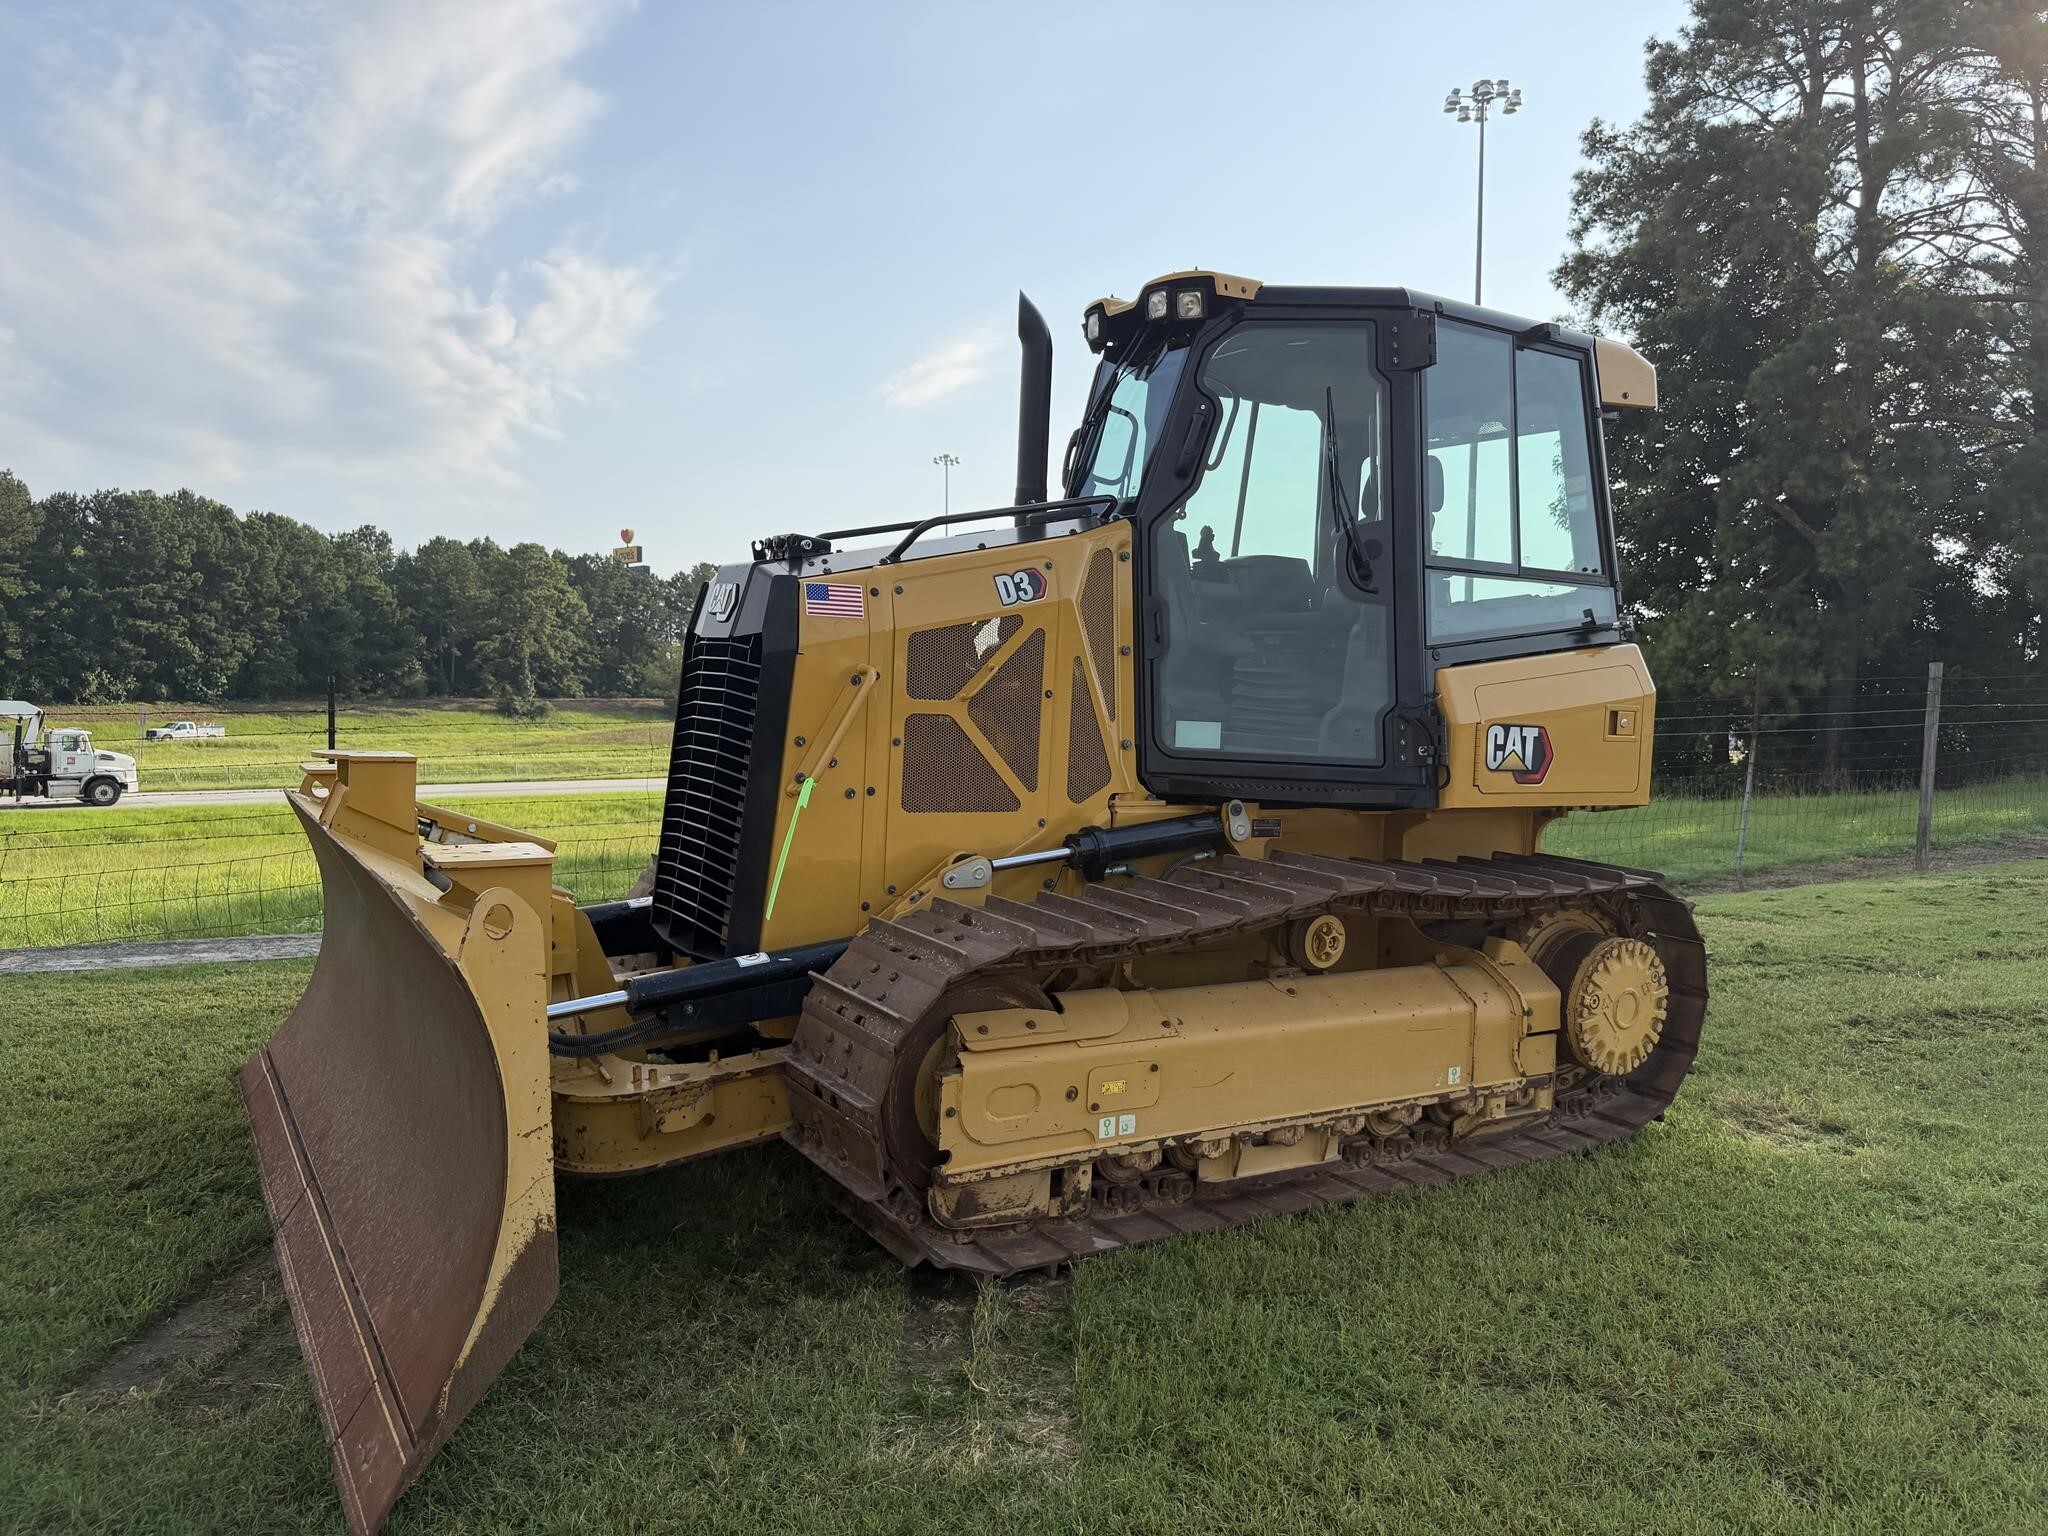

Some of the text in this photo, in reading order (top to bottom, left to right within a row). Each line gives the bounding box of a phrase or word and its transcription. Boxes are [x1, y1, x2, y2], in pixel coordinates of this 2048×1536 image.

[708, 583, 733, 613] CAT
[995, 571, 1034, 605] D3
[1487, 725, 1539, 770] CAT
